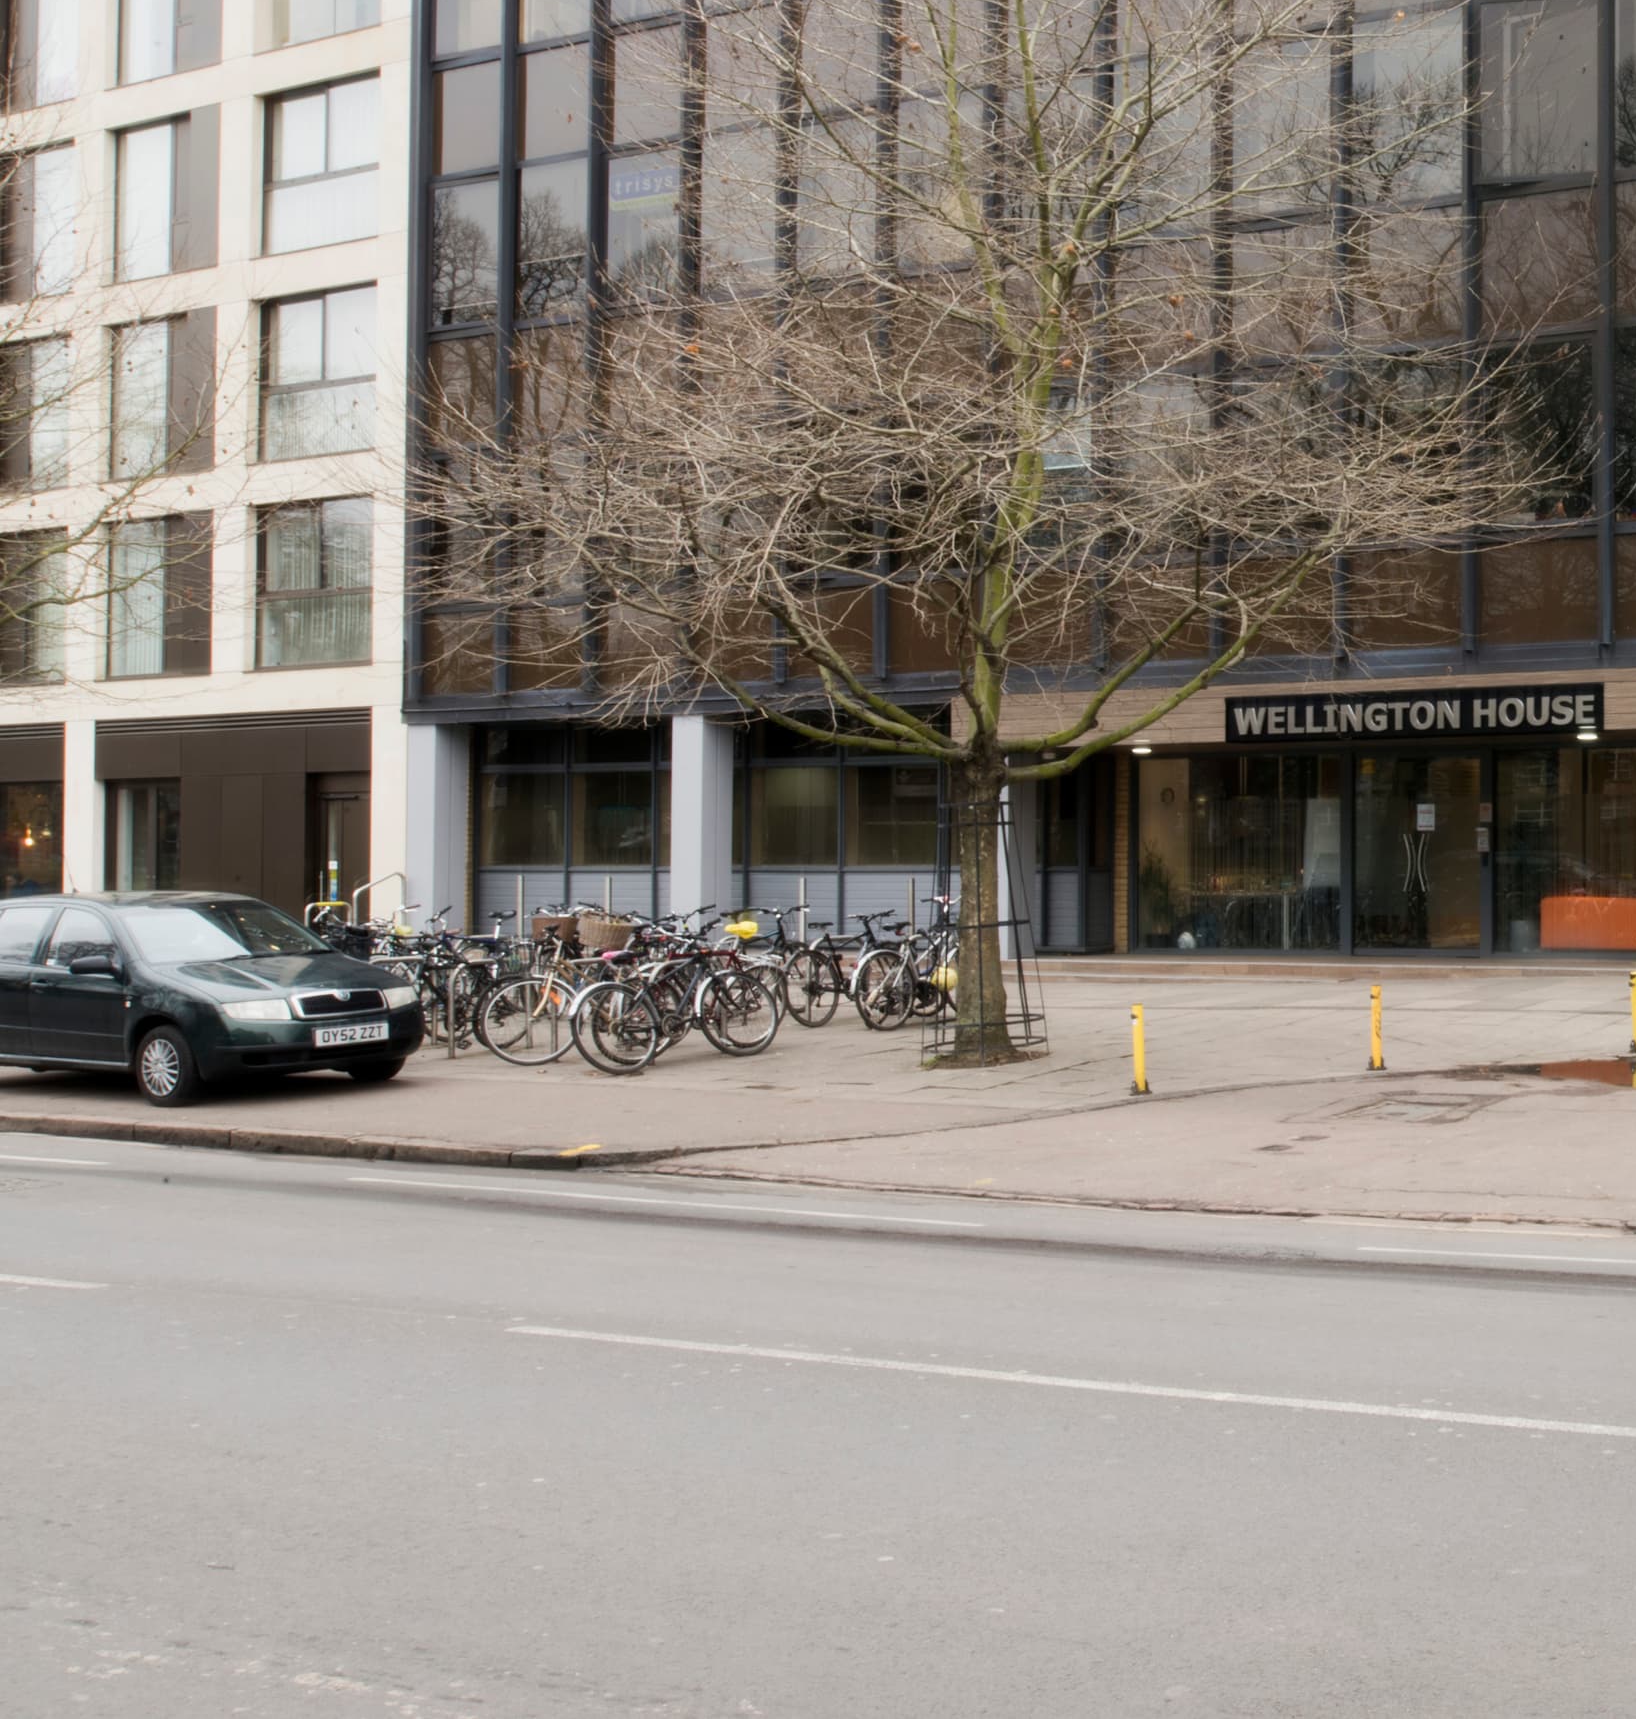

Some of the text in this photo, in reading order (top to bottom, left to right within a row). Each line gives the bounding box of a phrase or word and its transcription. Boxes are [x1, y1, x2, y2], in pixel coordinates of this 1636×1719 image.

[614, 175, 674, 195] trisys
[1233, 694, 1595, 736] WELLINGTON HOUSE
[360, 1025, 383, 1040] ZZT
